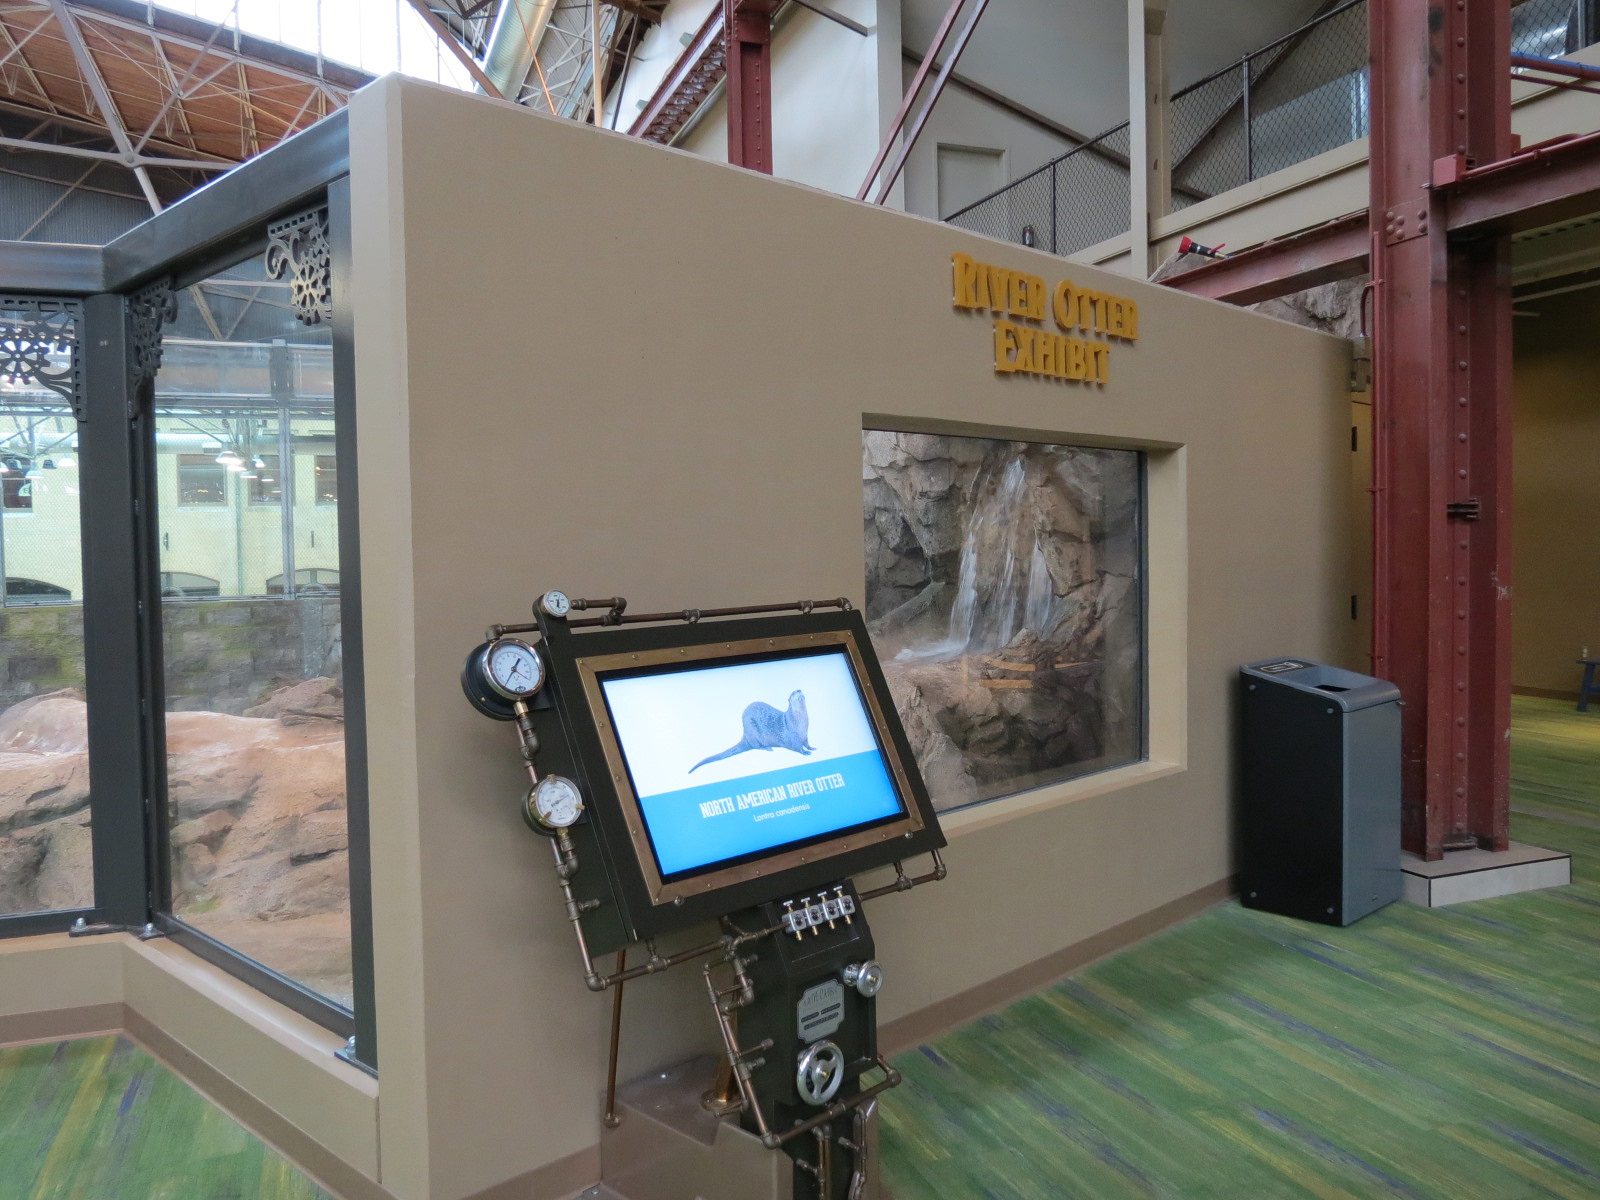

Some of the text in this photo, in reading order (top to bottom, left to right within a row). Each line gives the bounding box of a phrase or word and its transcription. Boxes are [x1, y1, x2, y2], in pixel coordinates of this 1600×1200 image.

[952, 252, 1140, 340] RIVER OTTER
[993, 319, 1111, 384] EXHIBIT
[699, 773, 845, 818] NORTH AMERICAN RIVER OTTER
